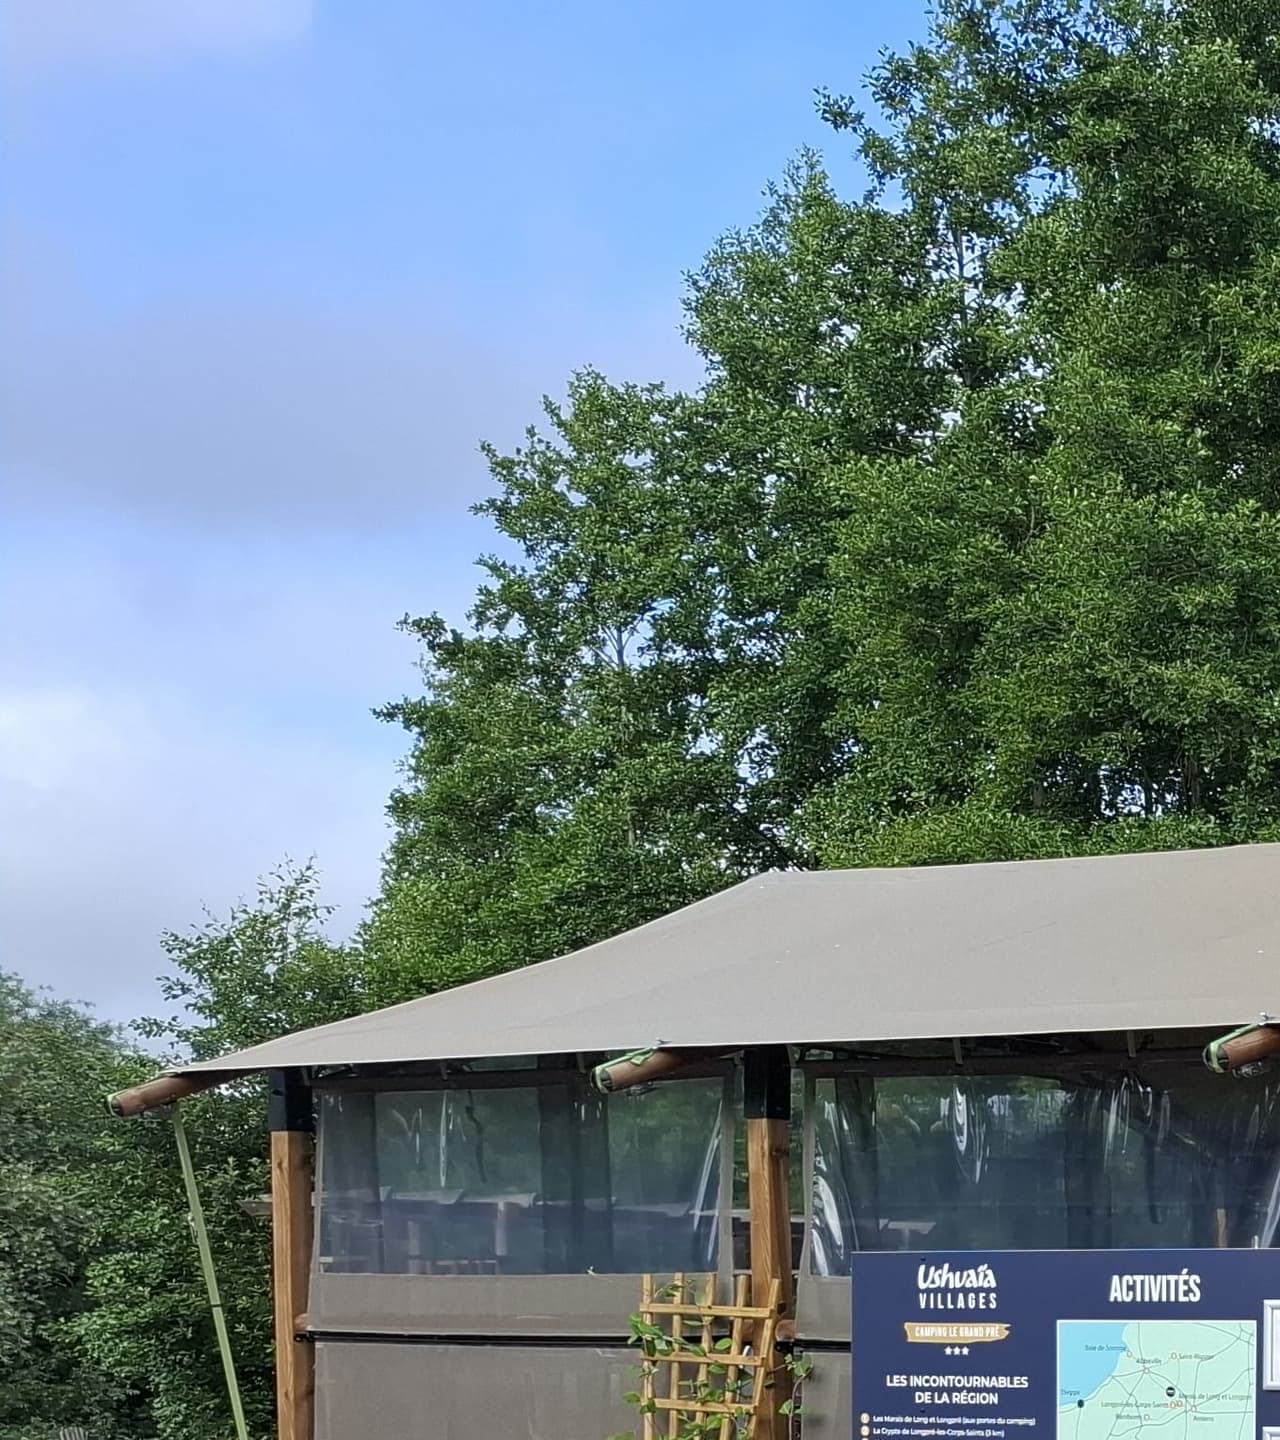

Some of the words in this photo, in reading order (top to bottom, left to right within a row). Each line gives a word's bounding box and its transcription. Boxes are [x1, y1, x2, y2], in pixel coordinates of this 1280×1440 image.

[1109, 1268, 1202, 1304] ACTIVITÉS
[919, 1292, 997, 1309] VILLAGES
[915, 1325, 947, 1337] CAMPING
[949, 1325, 958, 1337] LE
[959, 1325, 983, 1337] GRAND
[985, 1325, 1000, 1337] PRÉ
[886, 1375, 908, 1387] LES
[910, 1375, 1029, 1388] INCONTOURNABLES
[915, 1392, 932, 1404] DE
[934, 1392, 950, 1404] LA
[952, 1389, 999, 1405] RÉGION
